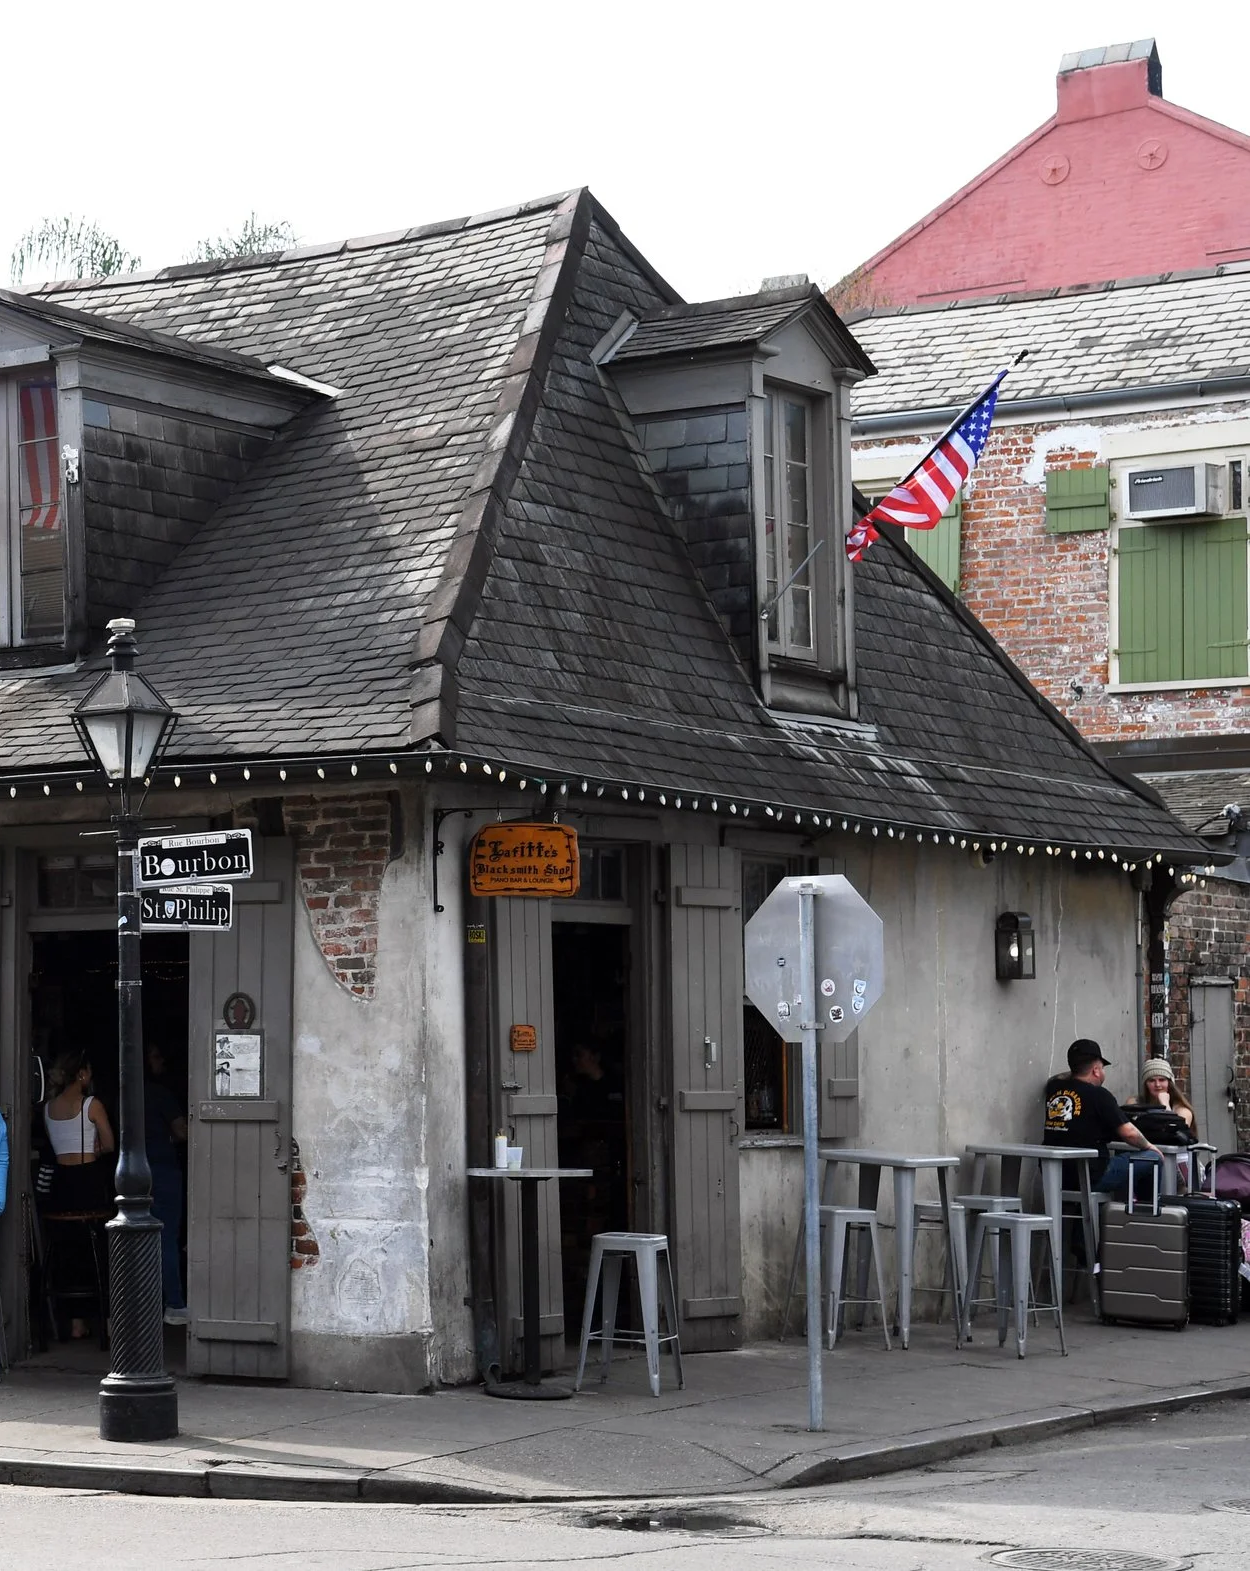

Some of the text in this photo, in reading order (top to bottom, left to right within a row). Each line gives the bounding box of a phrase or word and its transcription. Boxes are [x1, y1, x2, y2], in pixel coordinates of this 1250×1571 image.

[168, 836, 220, 848] Rue Bourbon
[144, 850, 247, 876] Burbon
[476, 863, 571, 877] Blacksmith Shop
[143, 897, 228, 925] St. Philip
